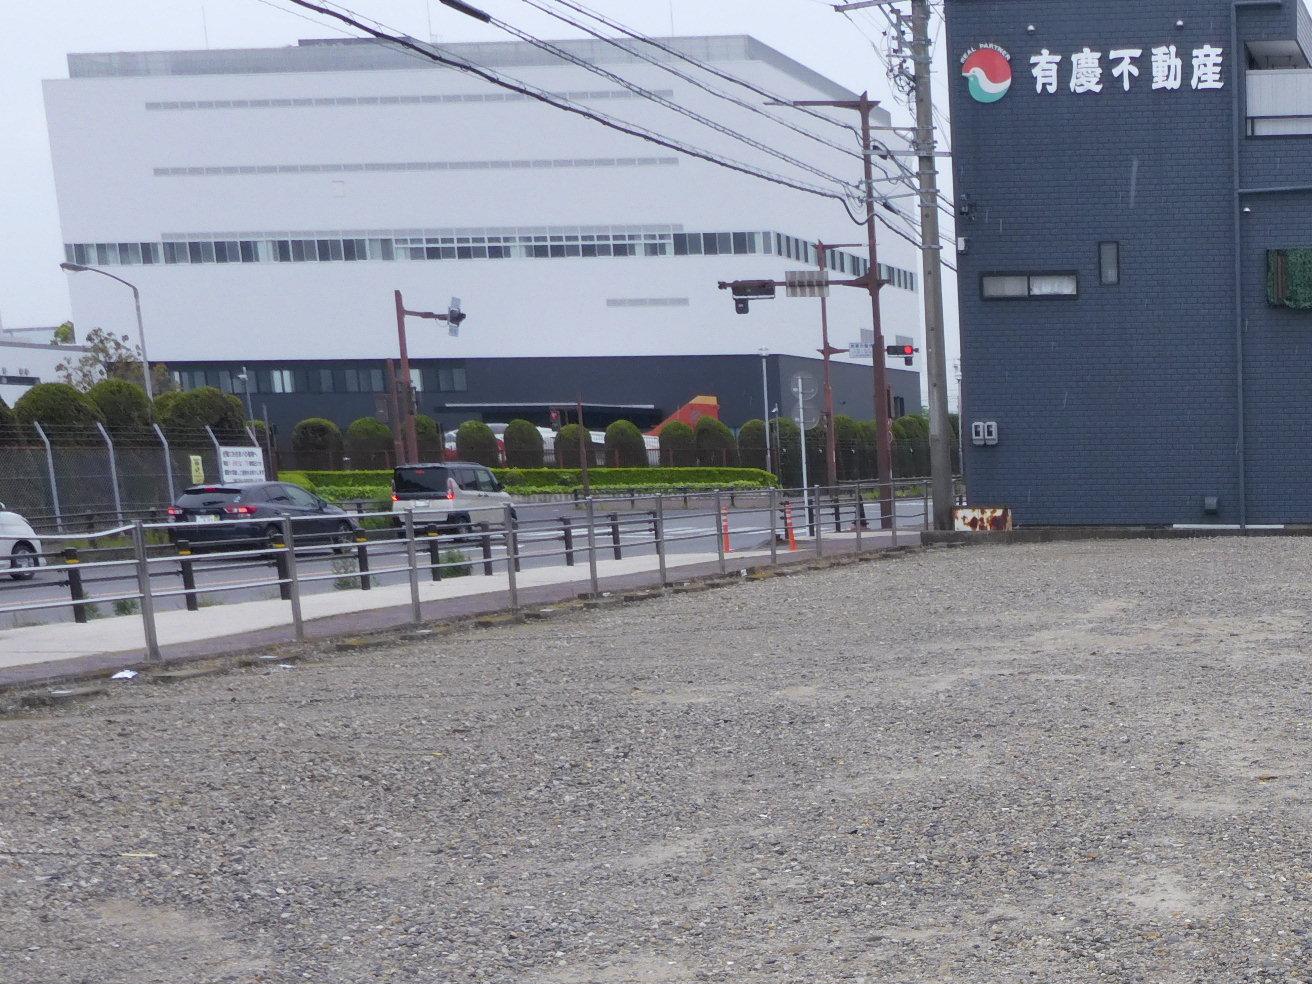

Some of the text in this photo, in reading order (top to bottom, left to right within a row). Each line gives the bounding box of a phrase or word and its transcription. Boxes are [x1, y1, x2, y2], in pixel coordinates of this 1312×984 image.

[978, 42, 1012, 61] PARTNER
[1029, 44, 1224, 94] 有慶不動産
